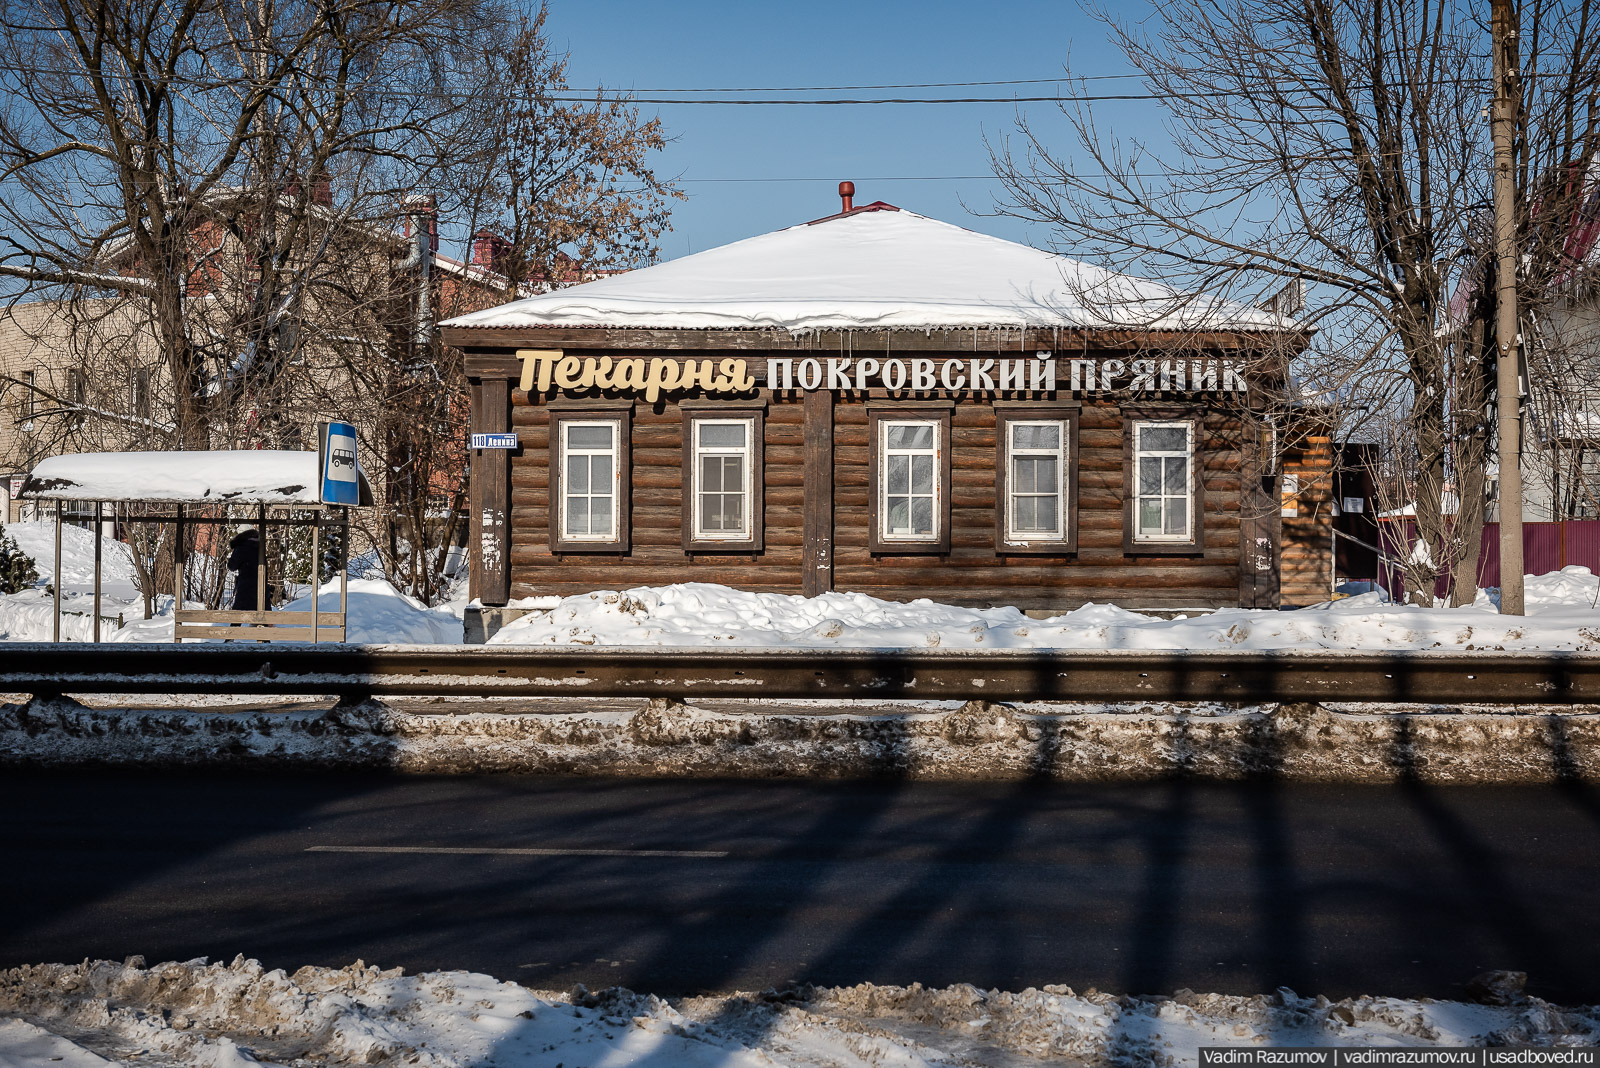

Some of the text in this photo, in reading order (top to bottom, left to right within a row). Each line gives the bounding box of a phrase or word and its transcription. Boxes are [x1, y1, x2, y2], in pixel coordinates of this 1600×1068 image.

[515, 349, 1249, 403] Пекарня ПОКРОВСКИЙ ПРЯНИК
[473, 435, 516, 447] 118 Ленина
